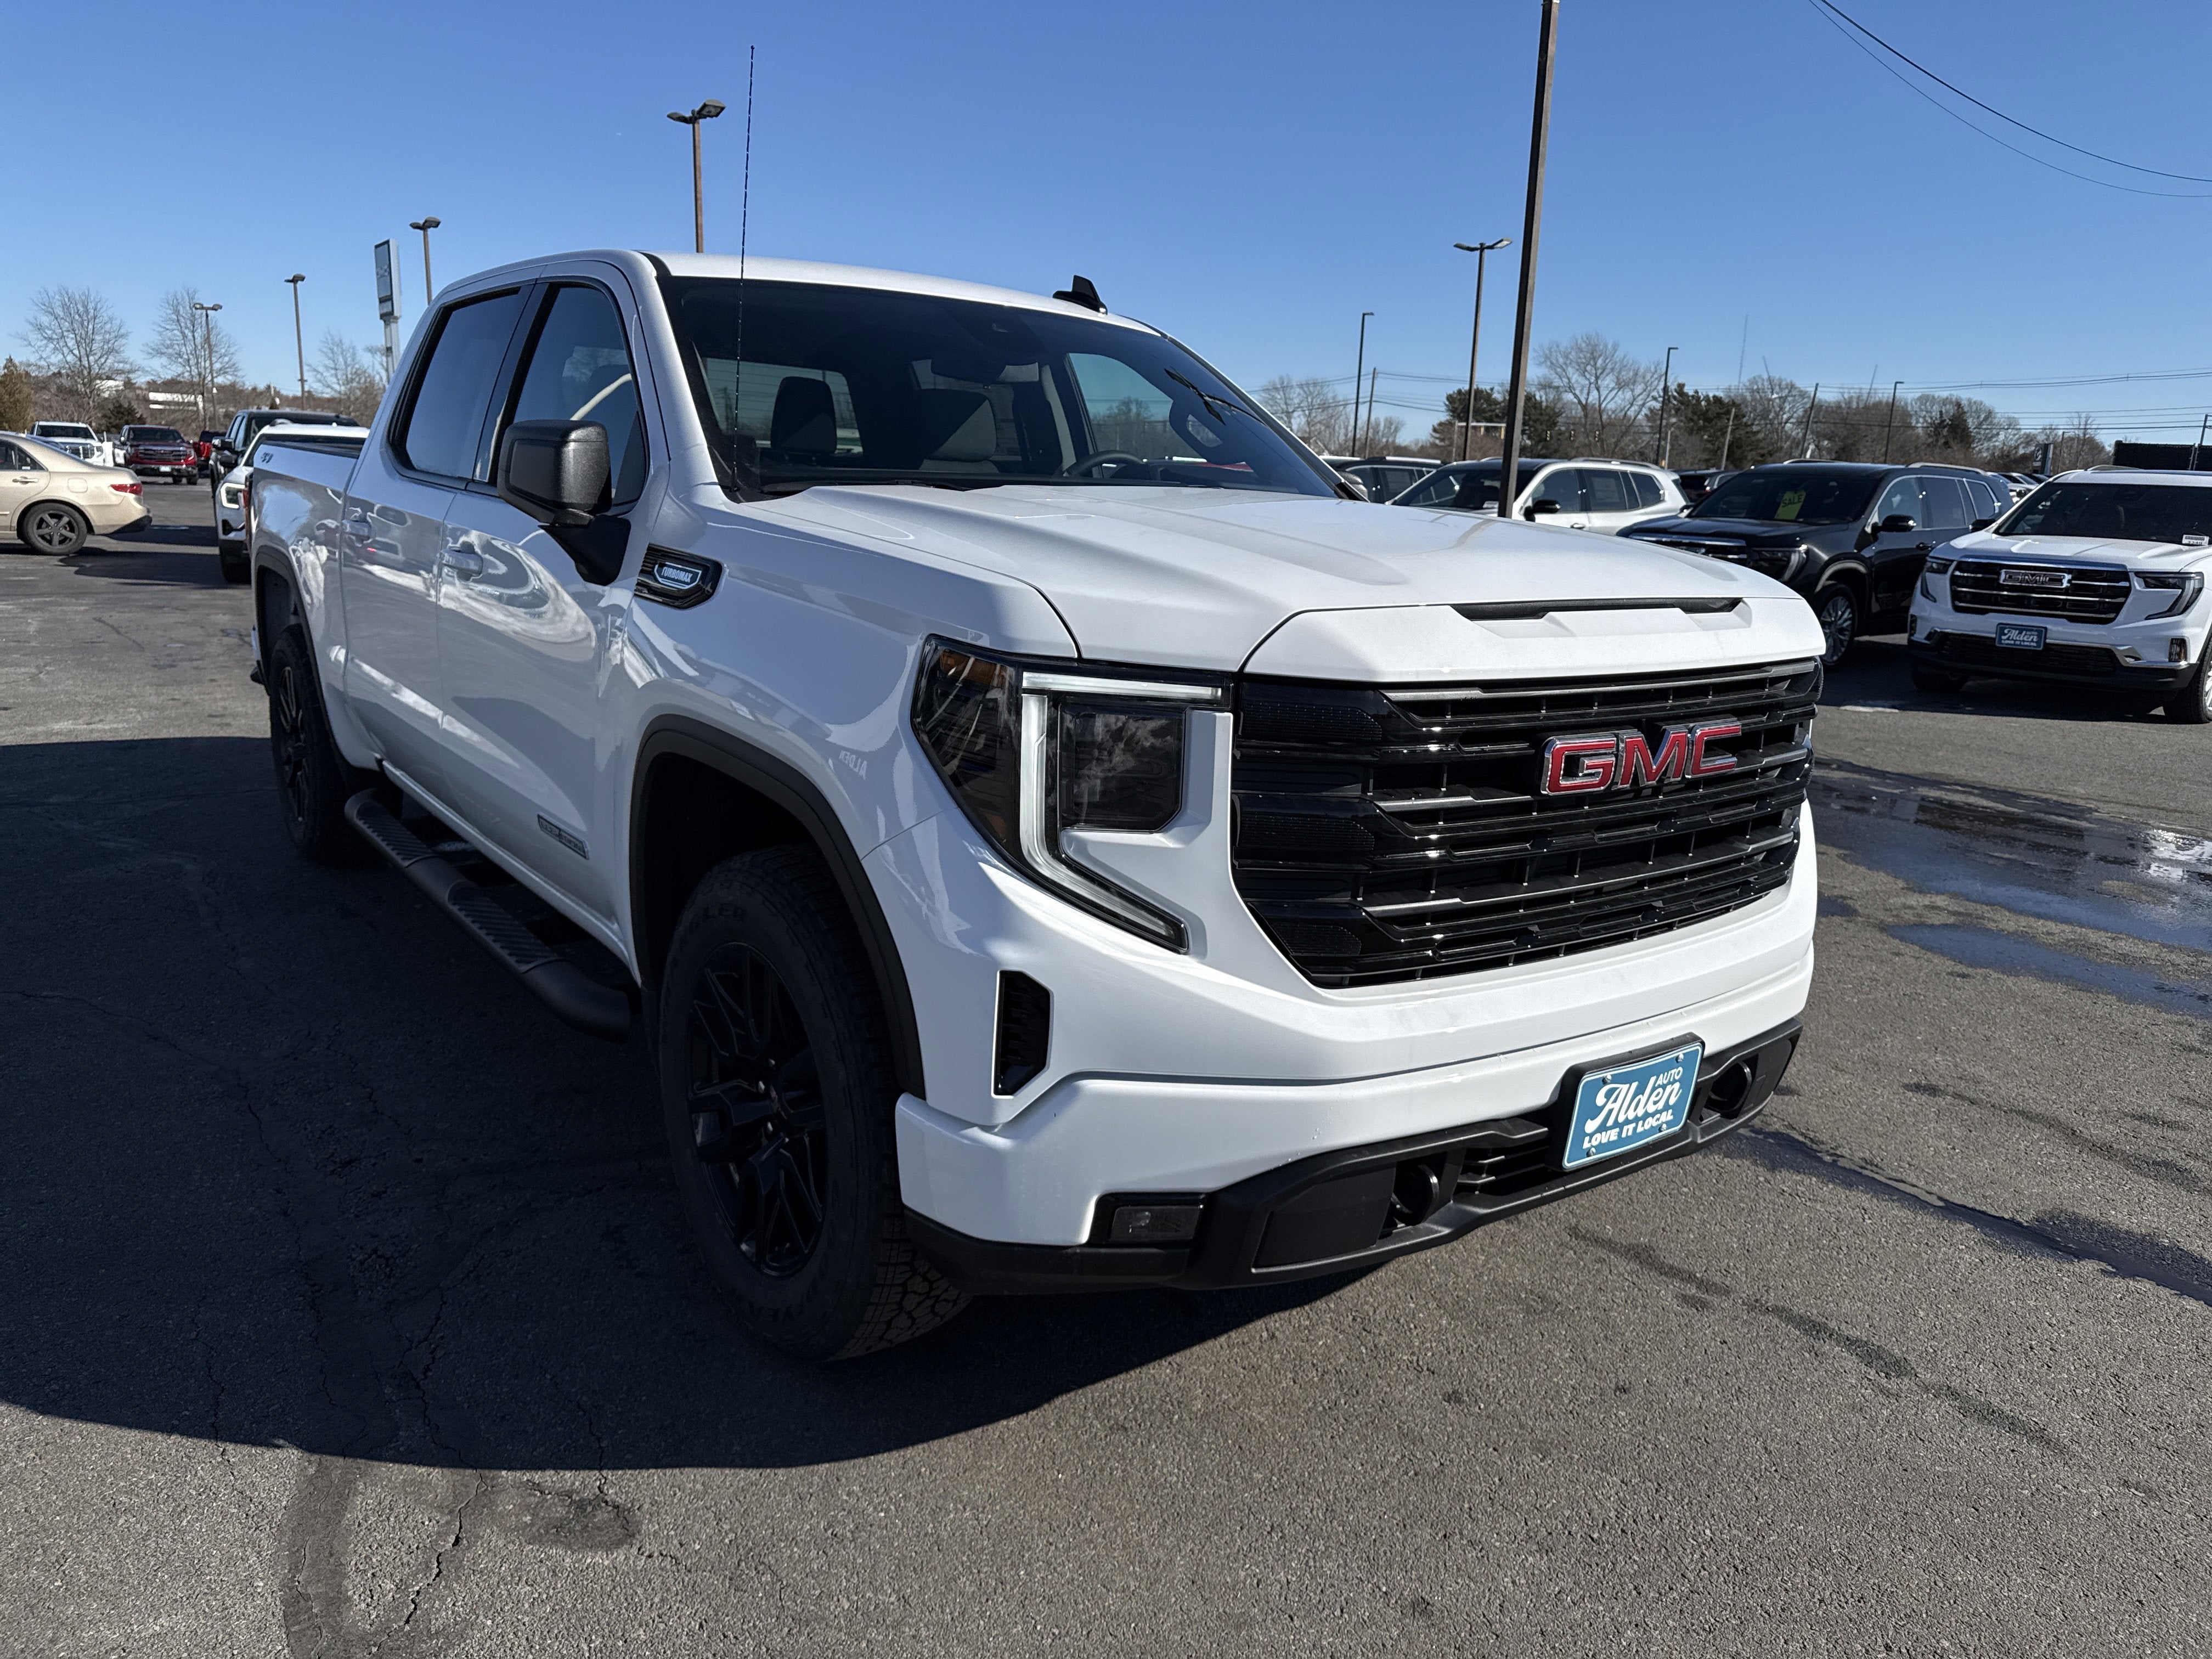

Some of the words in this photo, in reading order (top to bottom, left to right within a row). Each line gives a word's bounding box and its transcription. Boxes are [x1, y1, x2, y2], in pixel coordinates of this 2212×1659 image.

[1781, 494, 1803, 507] SALE
[662, 566, 693, 583] TURBOMAX
[2005, 571, 2063, 586] GMC
[2001, 628, 2038, 642] Alden
[1541, 720, 1741, 796] GMC
[1655, 1066, 1683, 1087] AUTO
[1584, 1075, 1683, 1134] Alden
[1583, 1127, 1620, 1149] LOVE
[1621, 1122, 1636, 1138] IT
[1636, 1109, 1674, 1133] LOCAL
